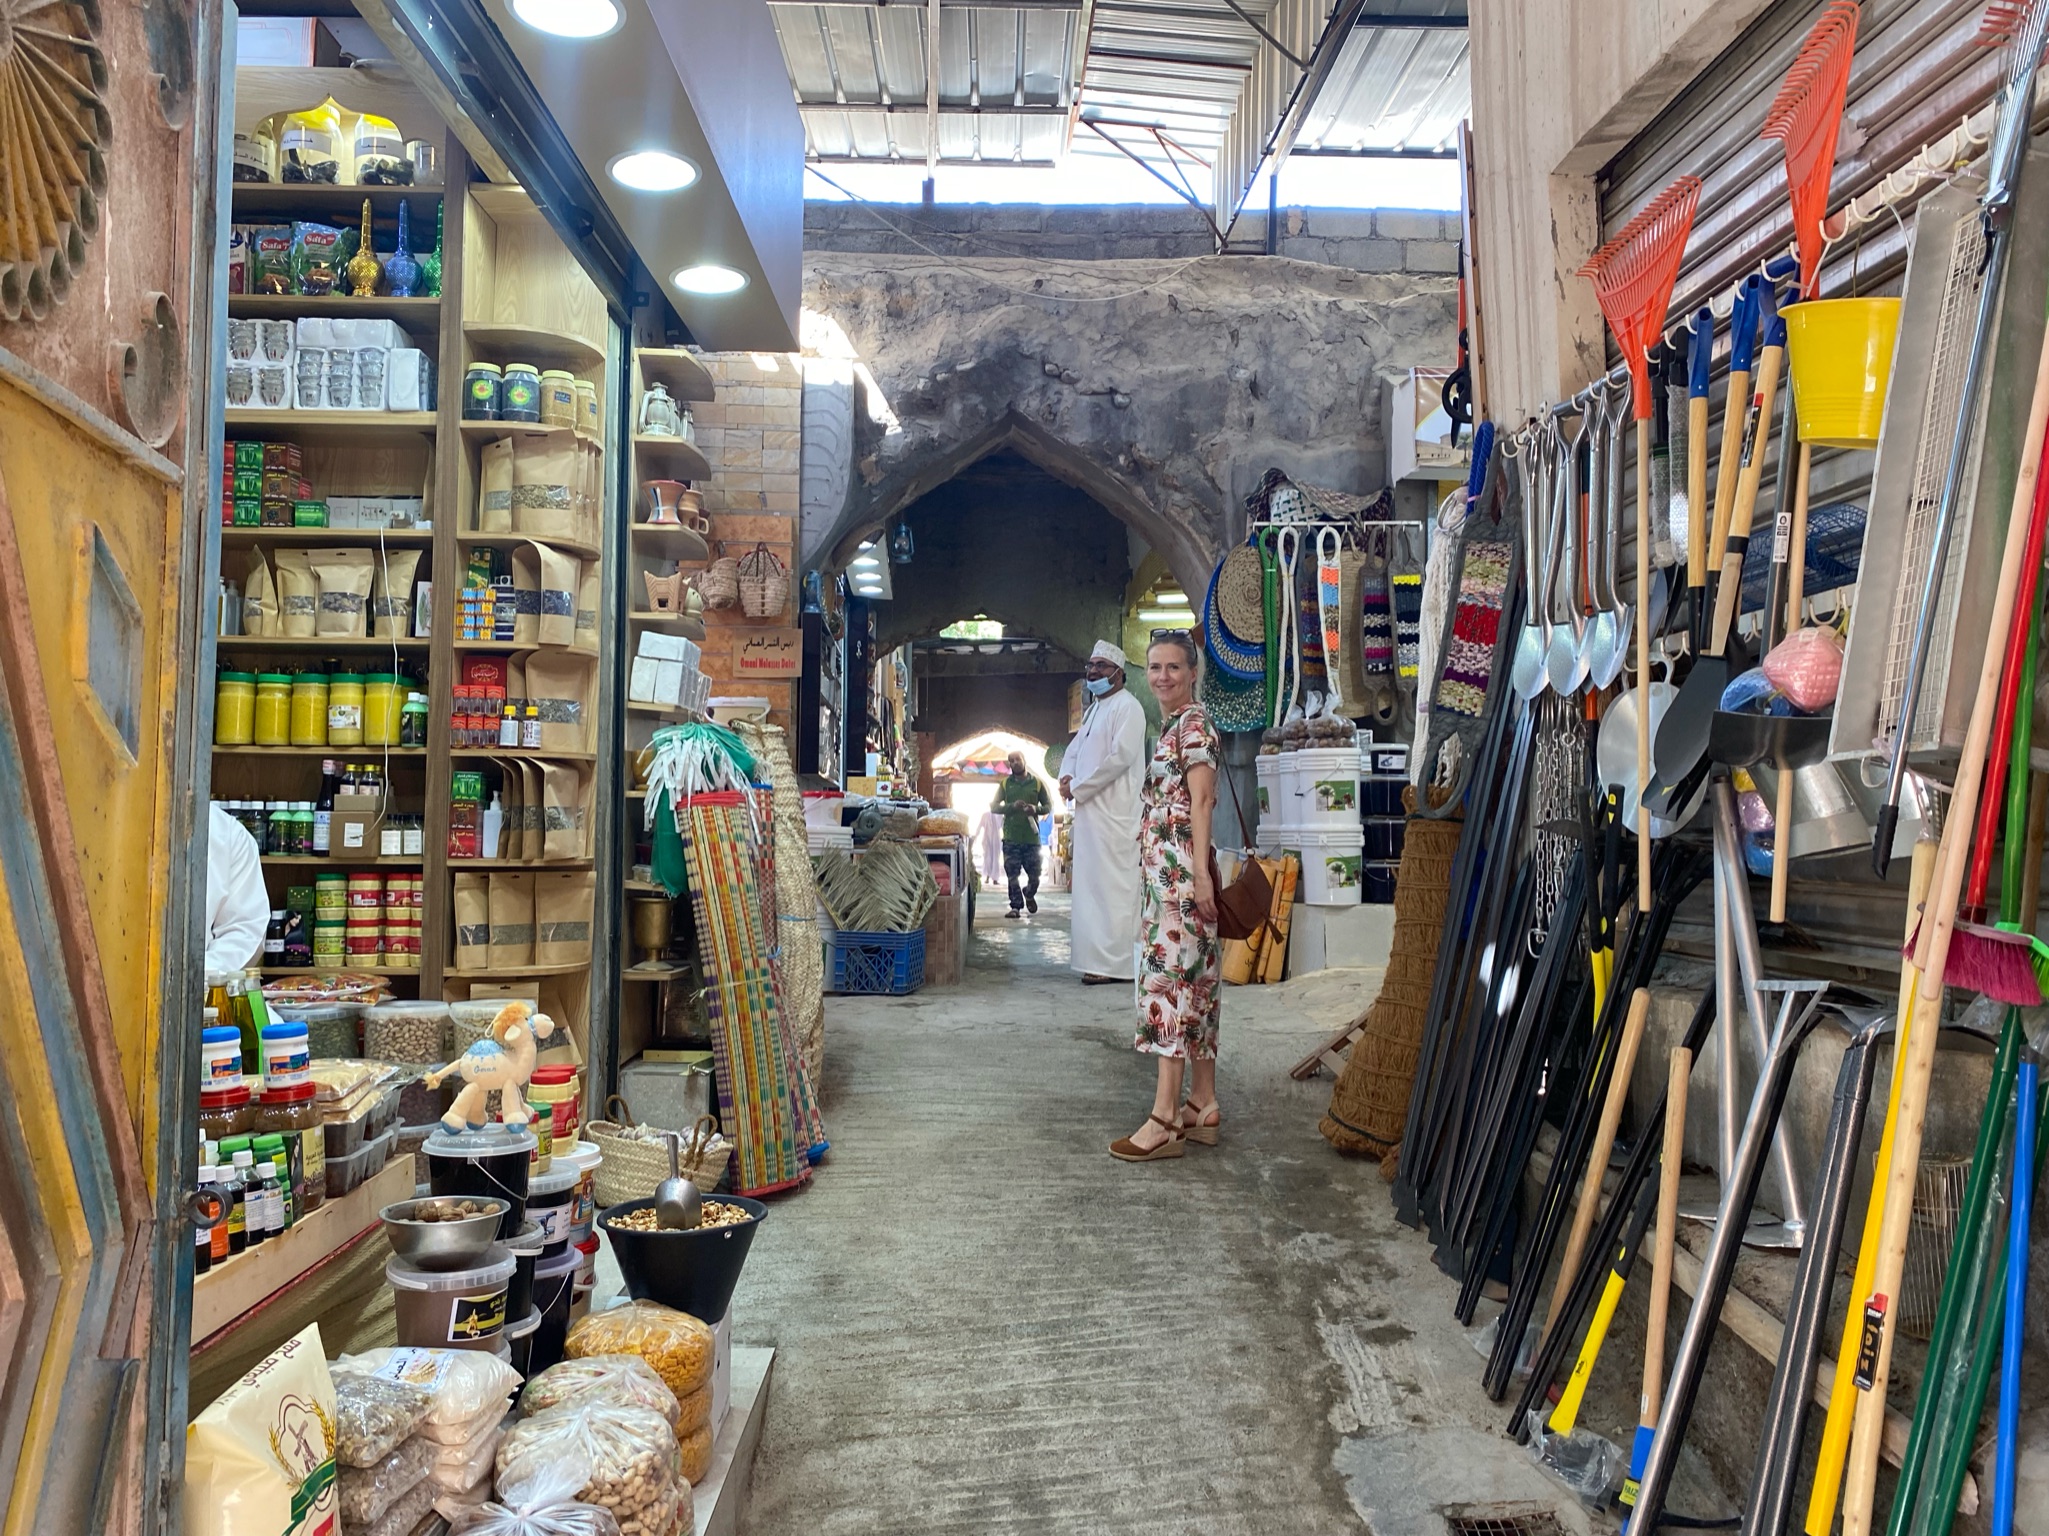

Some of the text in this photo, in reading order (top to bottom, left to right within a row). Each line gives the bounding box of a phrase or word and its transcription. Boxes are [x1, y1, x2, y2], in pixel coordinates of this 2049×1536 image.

[740, 657, 796, 669] Omani Molasses Dates
[474, 1065, 497, 1074] Oman
